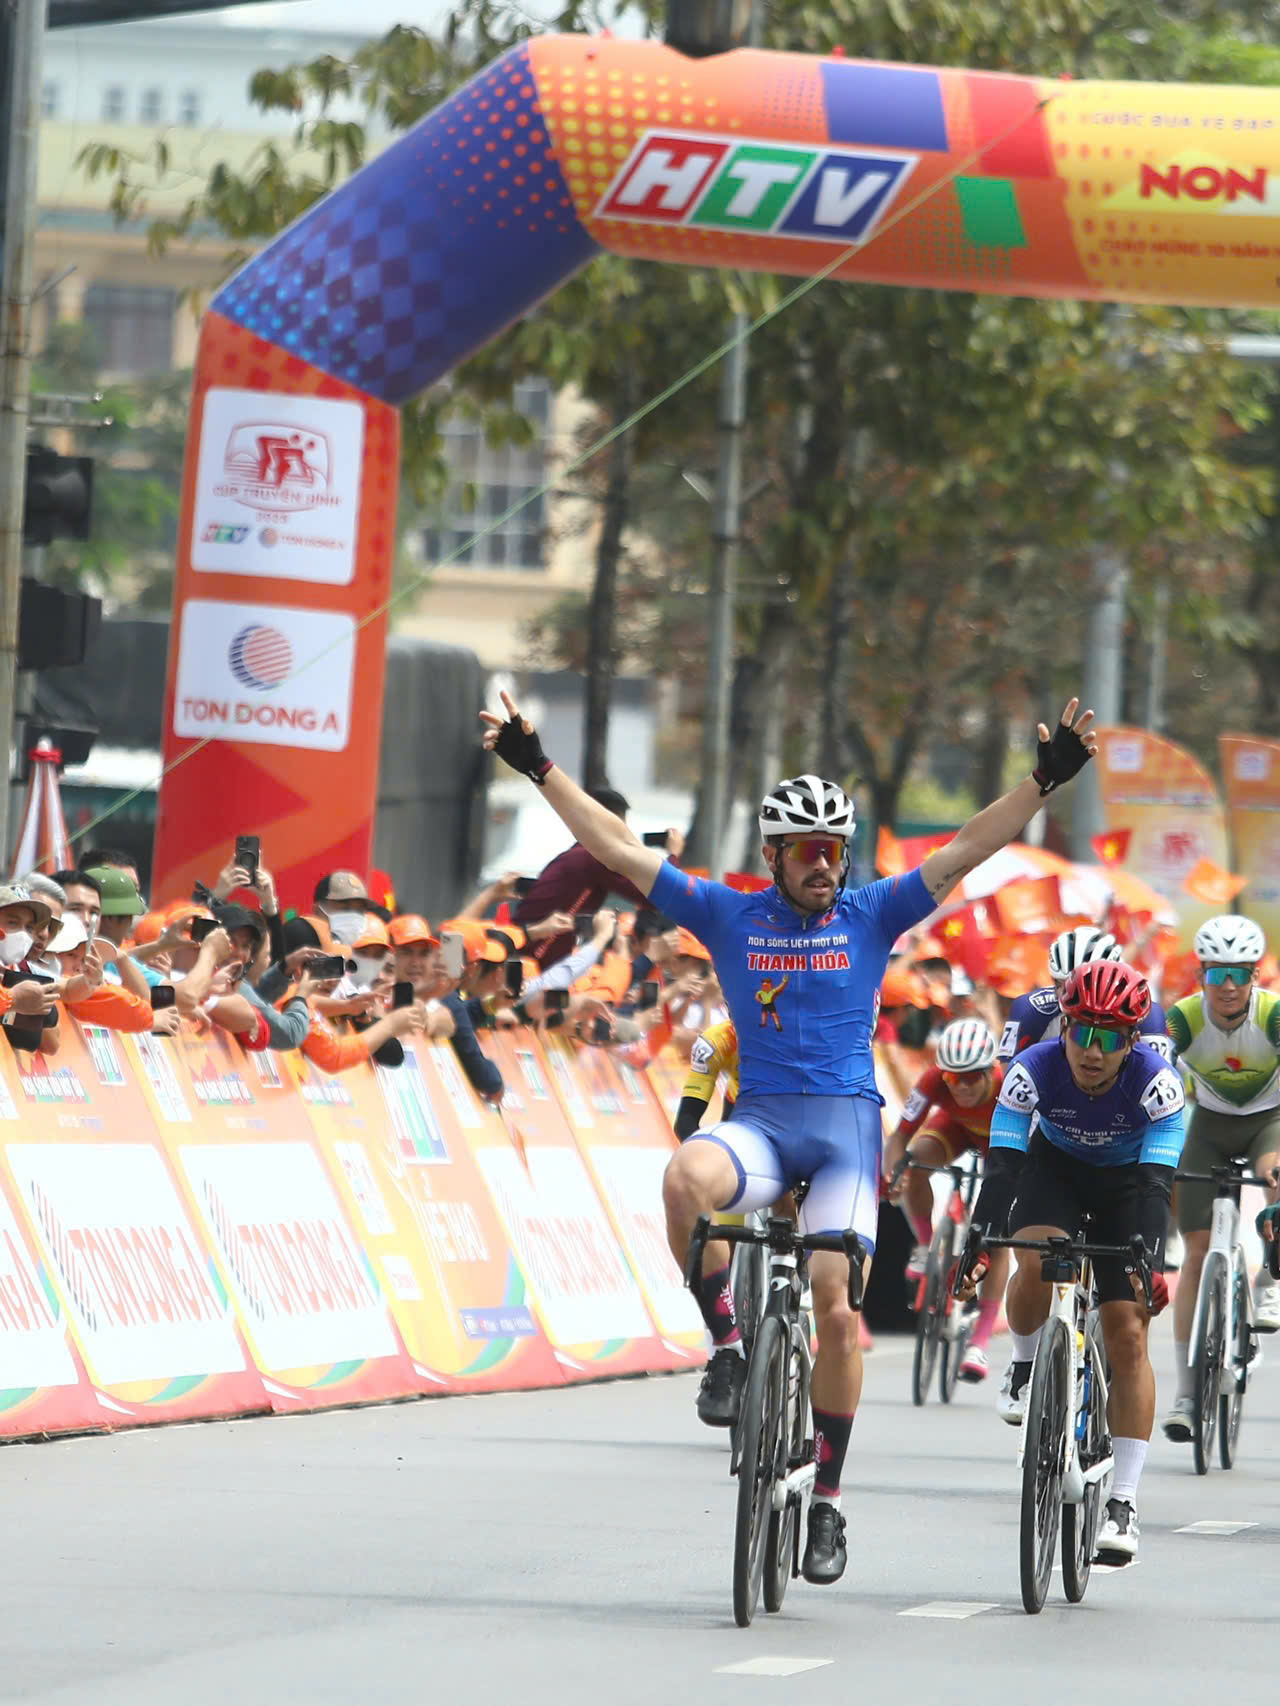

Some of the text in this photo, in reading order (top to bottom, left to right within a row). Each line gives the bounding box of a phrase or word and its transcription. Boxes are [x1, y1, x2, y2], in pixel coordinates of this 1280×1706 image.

[611, 144, 895, 231] HTV
[1139, 163, 1267, 202] NON
[182, 698, 341, 734] TON DONG A
[746, 949, 851, 972] THANH HÓA
[1008, 1073, 1032, 1102] 73
[1148, 1079, 1176, 1106] 73
